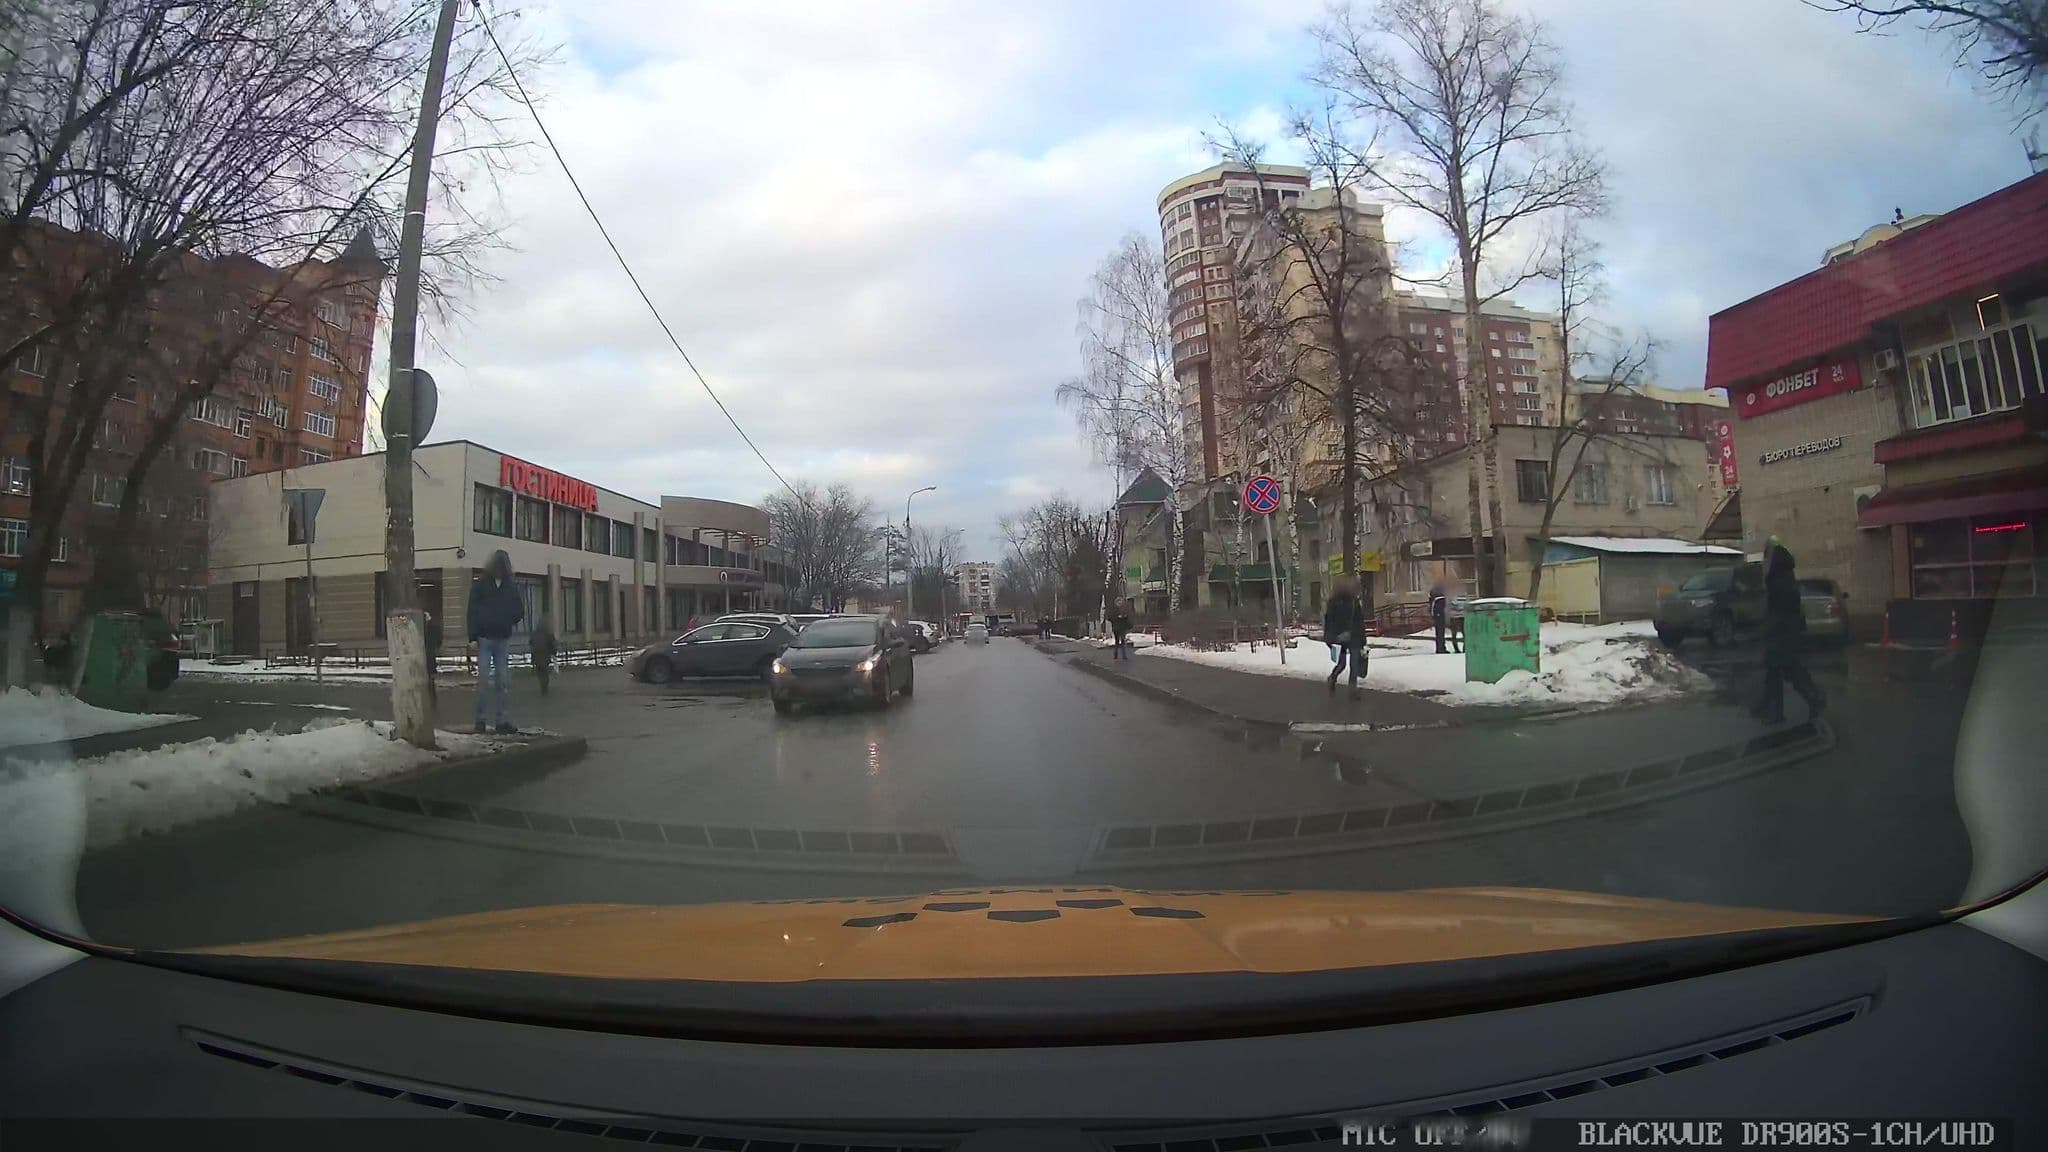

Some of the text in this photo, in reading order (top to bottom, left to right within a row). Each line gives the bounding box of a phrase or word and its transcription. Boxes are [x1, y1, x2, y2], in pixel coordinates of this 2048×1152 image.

[1766, 368, 1819, 398] ФОНБЕТ
[1831, 364, 1842, 377] 24
[1791, 436, 1841, 457] ПЕРЕВОДОВ
[501, 455, 599, 513] ГОСТИНИЦА
